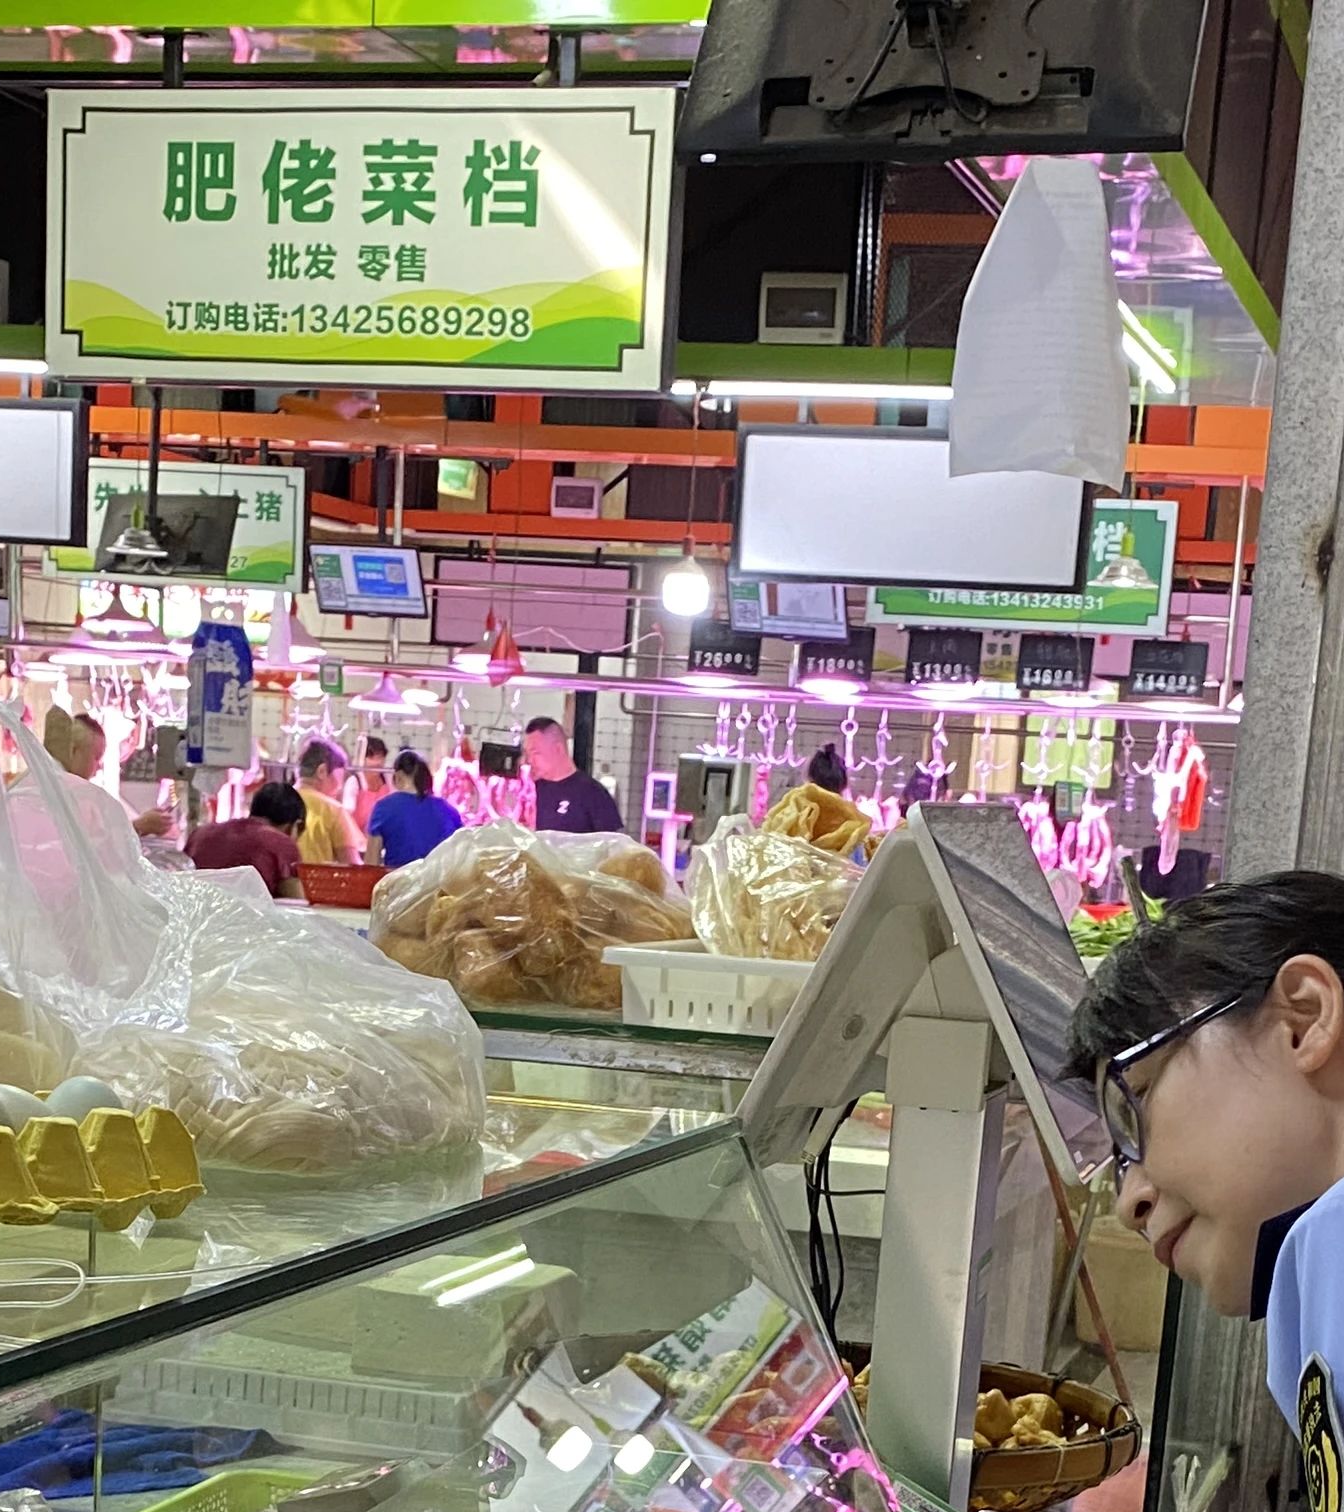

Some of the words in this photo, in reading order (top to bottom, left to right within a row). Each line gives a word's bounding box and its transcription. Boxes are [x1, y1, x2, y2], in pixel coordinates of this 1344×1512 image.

[163, 137, 541, 229] 肥佬菜档
[267, 242, 337, 282] 批发
[358, 244, 427, 284] 零售
[165, 300, 531, 340] 订购电话:13425689298
